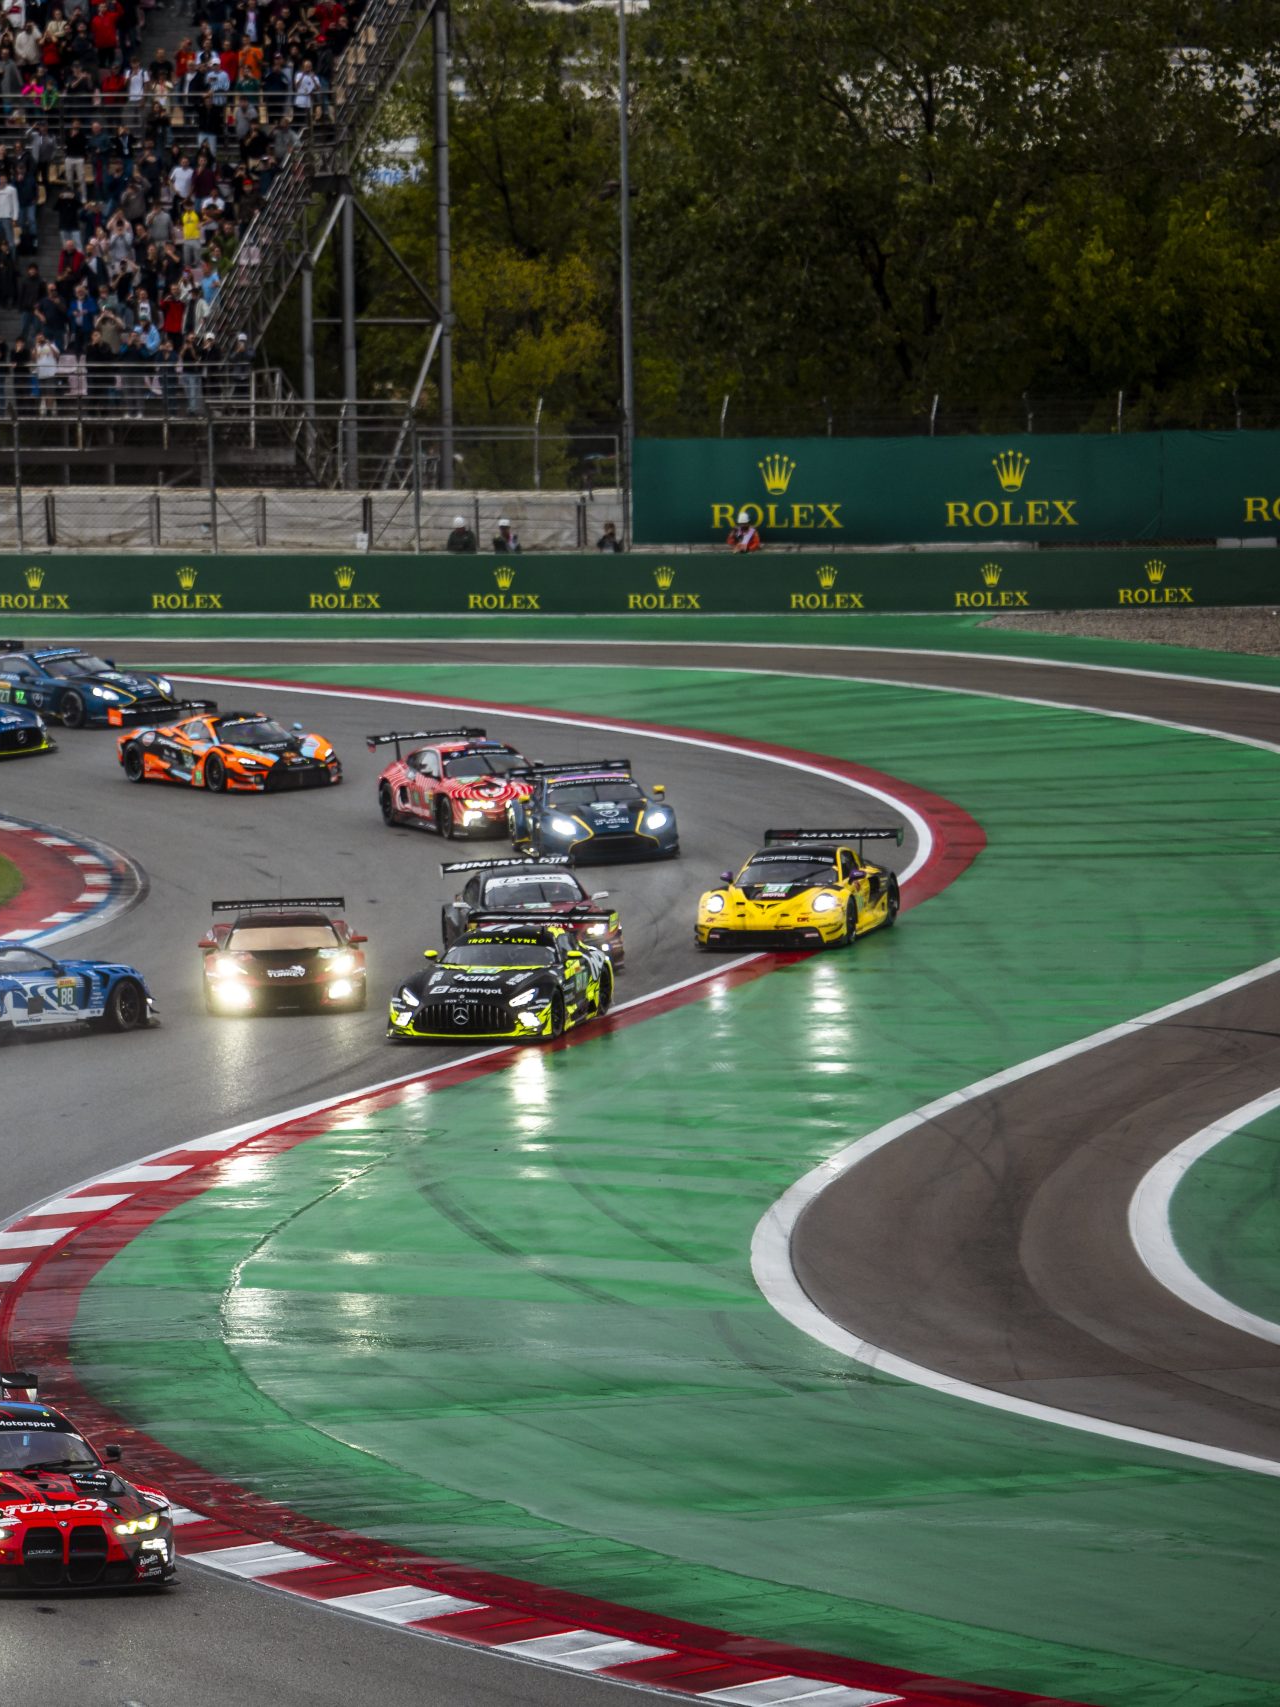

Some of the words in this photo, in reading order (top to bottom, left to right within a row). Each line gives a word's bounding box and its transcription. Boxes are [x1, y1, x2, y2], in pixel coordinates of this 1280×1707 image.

[711, 503, 843, 528] ROLEX
[946, 500, 1077, 527] ROLEX
[0, 593, 68, 609] ROLEX
[152, 594, 222, 610] ROLEX
[309, 593, 381, 609] ROLEX
[468, 593, 540, 609] ROLEX
[628, 593, 700, 609] ROLEX
[790, 593, 864, 609] ROLEX
[955, 591, 1029, 607] ROLEX
[1119, 587, 1194, 604] ROLEX
[751, 855, 835, 864] PORSCHE
[60, 987, 74, 1006] 88
[447, 987, 503, 995] Sonangol
[5, 1503, 93, 1516] TURBO
